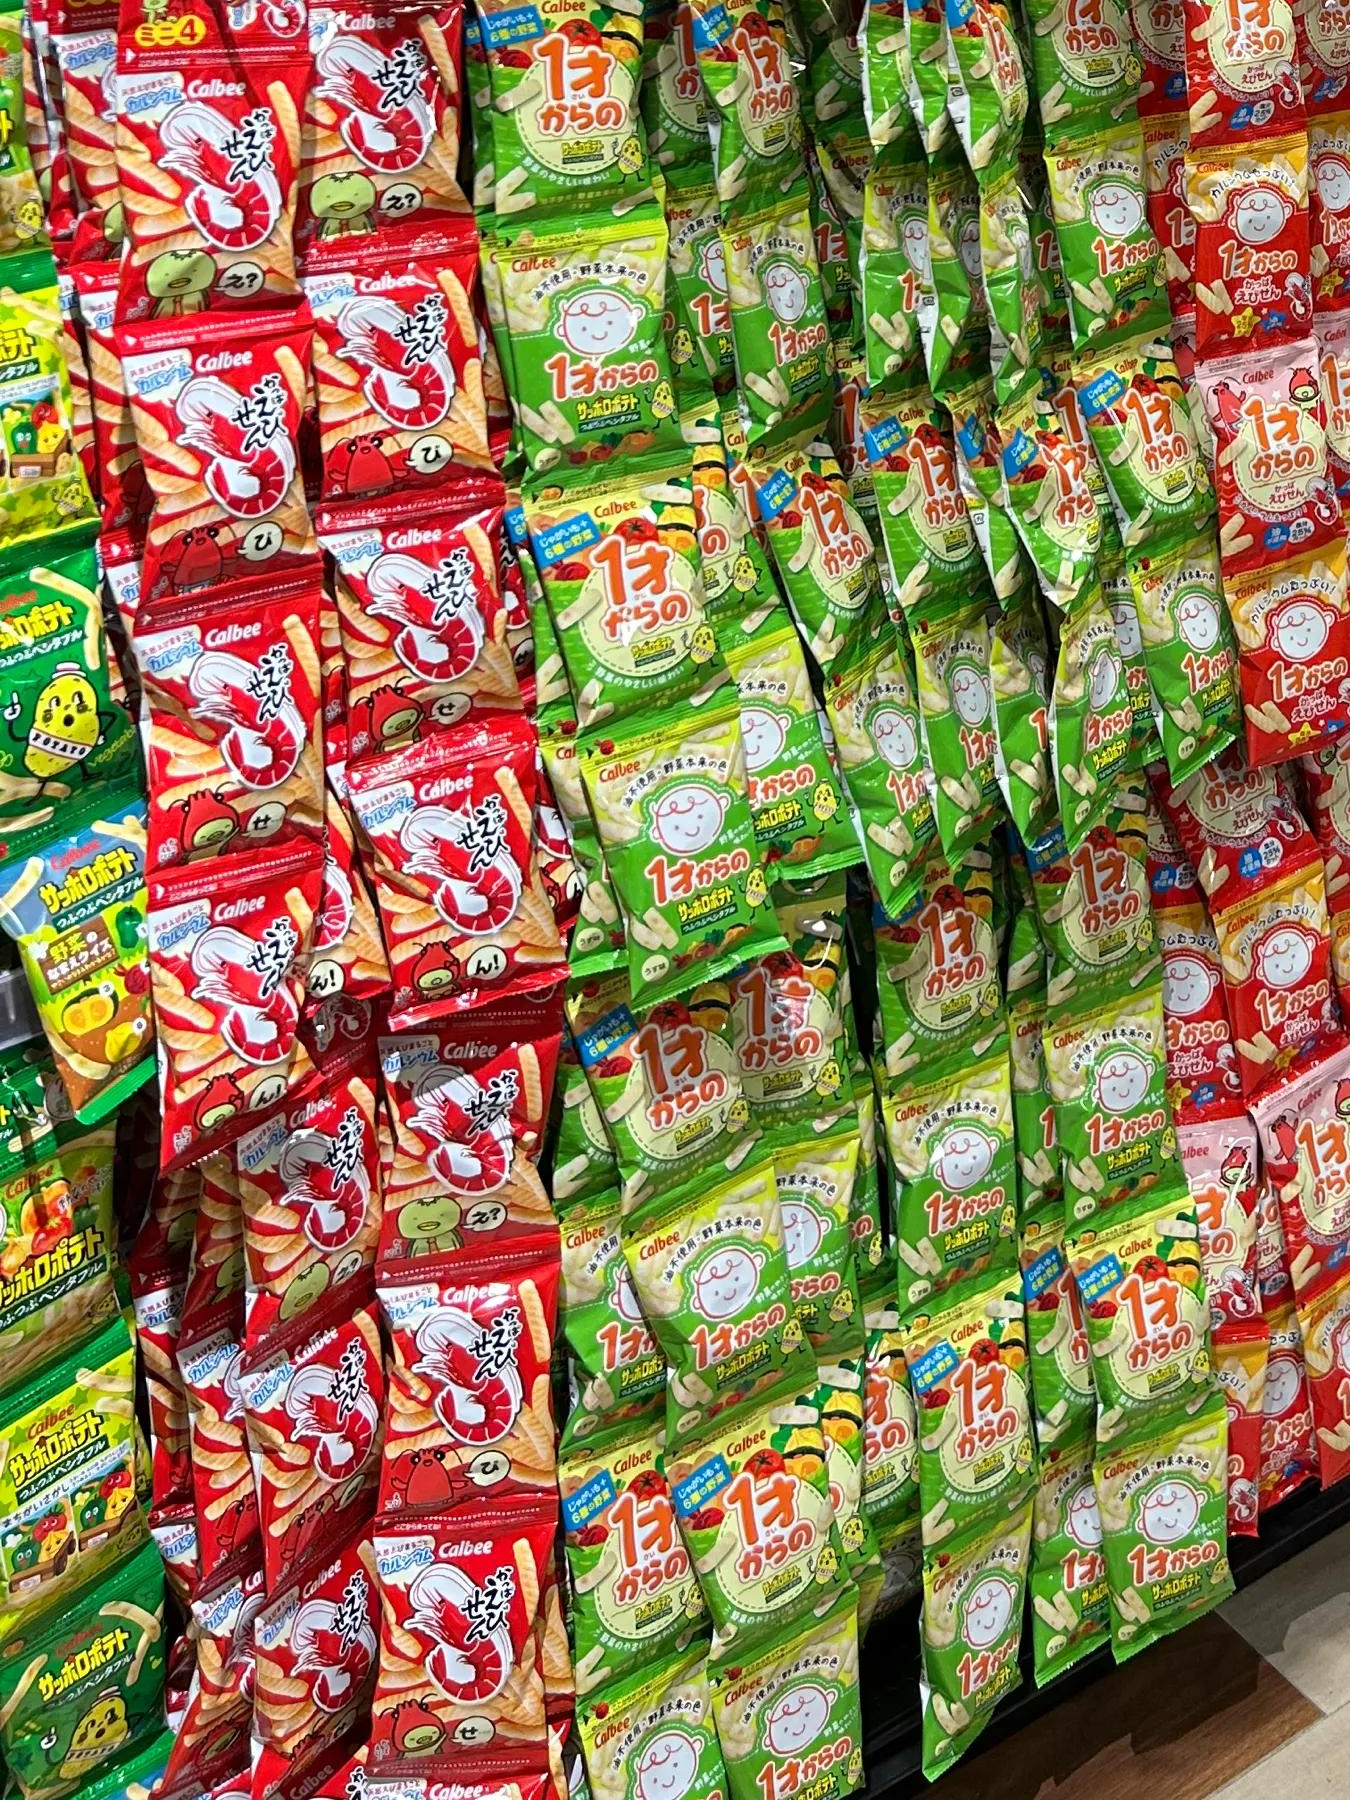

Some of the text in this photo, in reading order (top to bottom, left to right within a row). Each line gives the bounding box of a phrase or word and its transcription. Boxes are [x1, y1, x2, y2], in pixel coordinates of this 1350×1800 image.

[187, 79, 246, 97] Calbee
[195, 350, 253, 372] Calbee
[577, 397, 638, 419] サッポロポテト
[385, 528, 442, 549] Calbee
[0, 606, 73, 652] ッポロポテト
[204, 622, 262, 648] Calbee
[31, 734, 87, 755] POTATO
[418, 775, 474, 802] Calbee
[39, 849, 136, 913] サッポロポテト
[213, 896, 266, 922] Calbee
[678, 887, 734, 921] サッポロポテト
[944, 1222, 990, 1252] サッポロポテト
[1118, 1238, 1152, 1258] Calbee
[26, 1403, 75, 1437] Calbee
[8, 1412, 104, 1486] サッポロポテト
[726, 1430, 766, 1456] Calbee
[438, 1540, 493, 1558] Calbee
[38, 1628, 130, 1700] サッポロポテト
